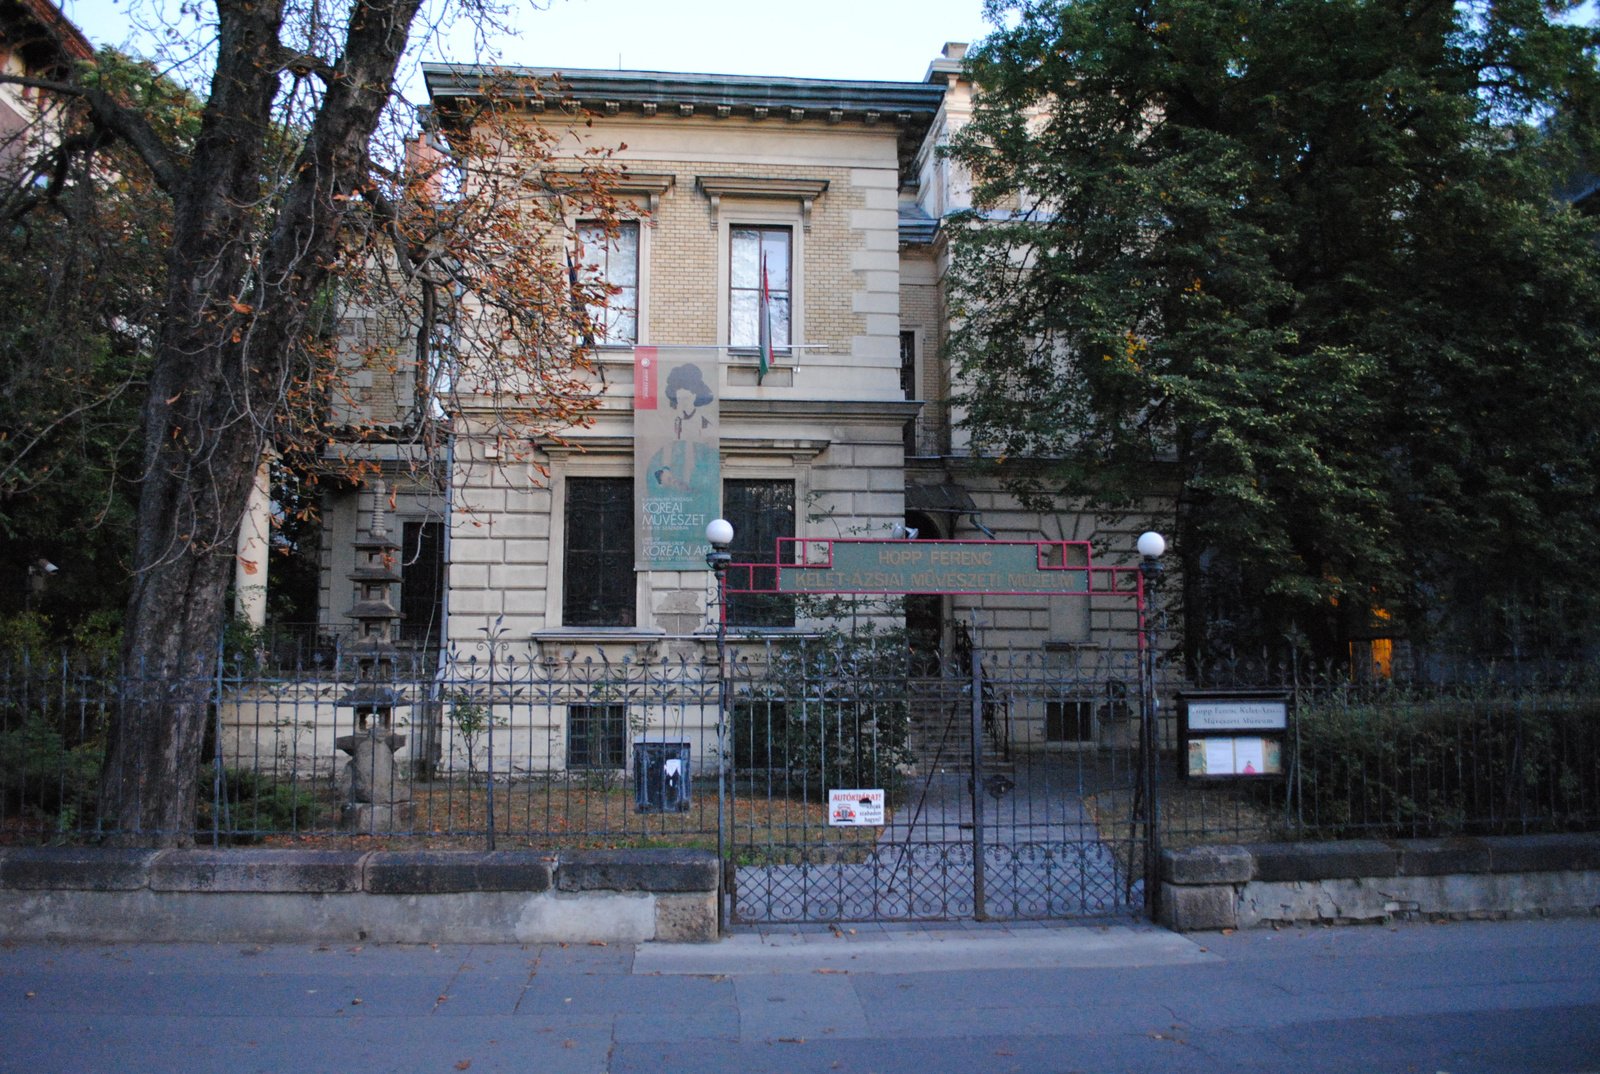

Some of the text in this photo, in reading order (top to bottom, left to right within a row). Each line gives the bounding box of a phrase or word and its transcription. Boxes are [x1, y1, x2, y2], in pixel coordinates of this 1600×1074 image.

[642, 502, 683, 513] KOREAI
[642, 545, 692, 556] KOREAN
[879, 551, 993, 565] HOPP FERENC
